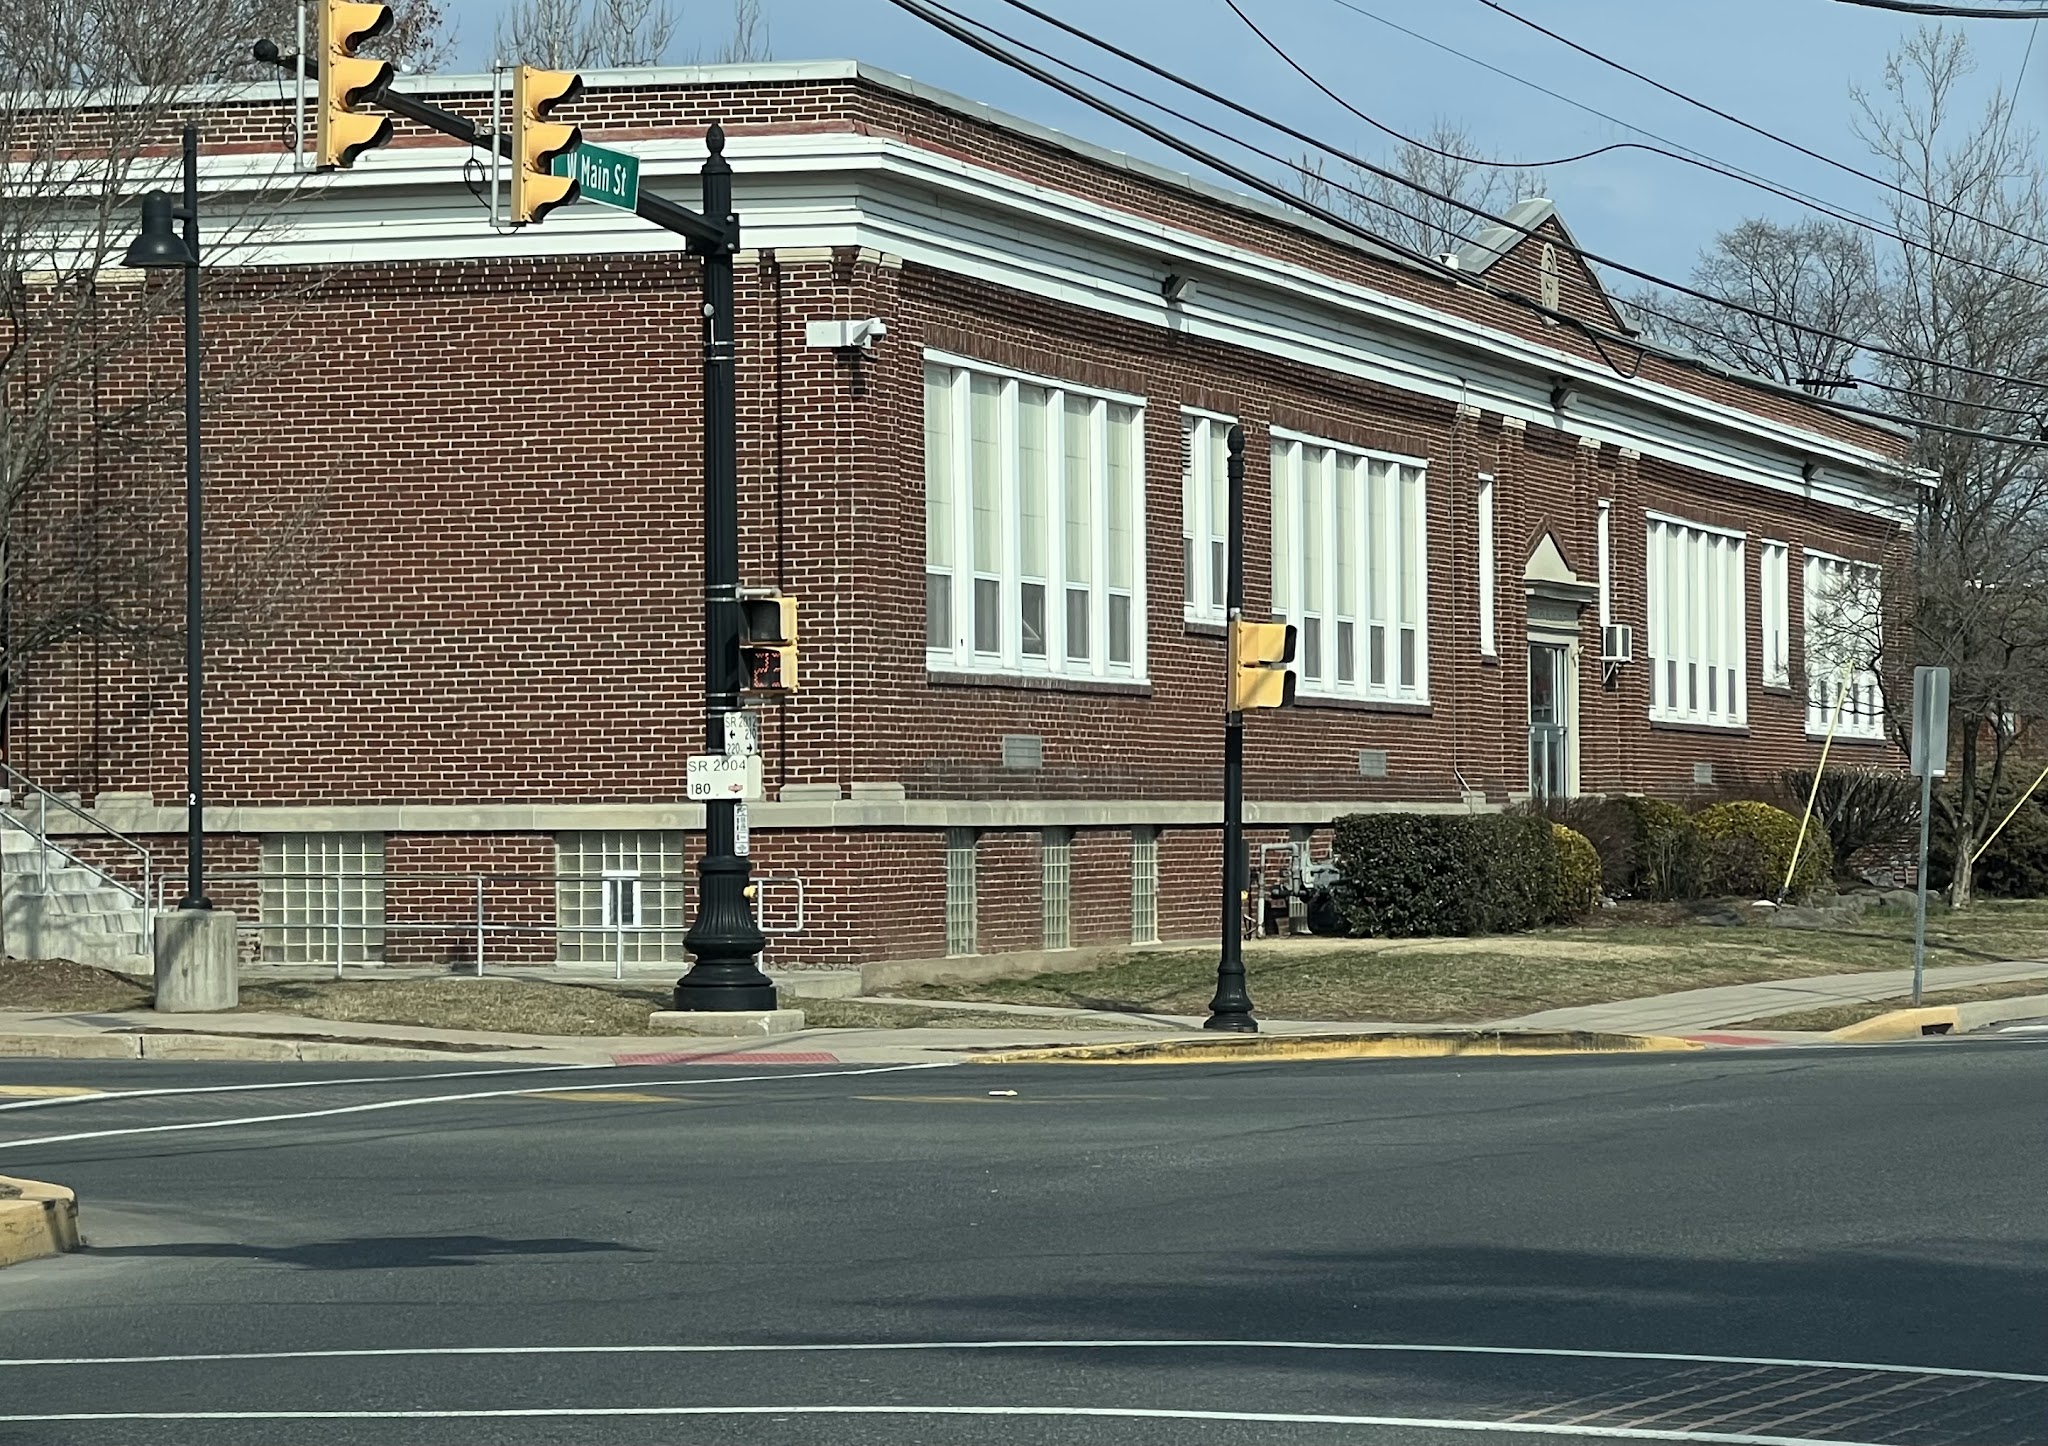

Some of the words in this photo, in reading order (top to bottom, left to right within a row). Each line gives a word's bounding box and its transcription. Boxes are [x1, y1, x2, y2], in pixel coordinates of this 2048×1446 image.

[567, 152, 577, 179] W
[581, 154, 610, 192] Main
[613, 163, 627, 197] St
[725, 716, 736, 728] SR
[727, 742, 740, 755] 220
[688, 760, 708, 772] SR
[713, 758, 746, 772] 2004
[691, 783, 711, 795] 180
[189, 793, 196, 805] 2
